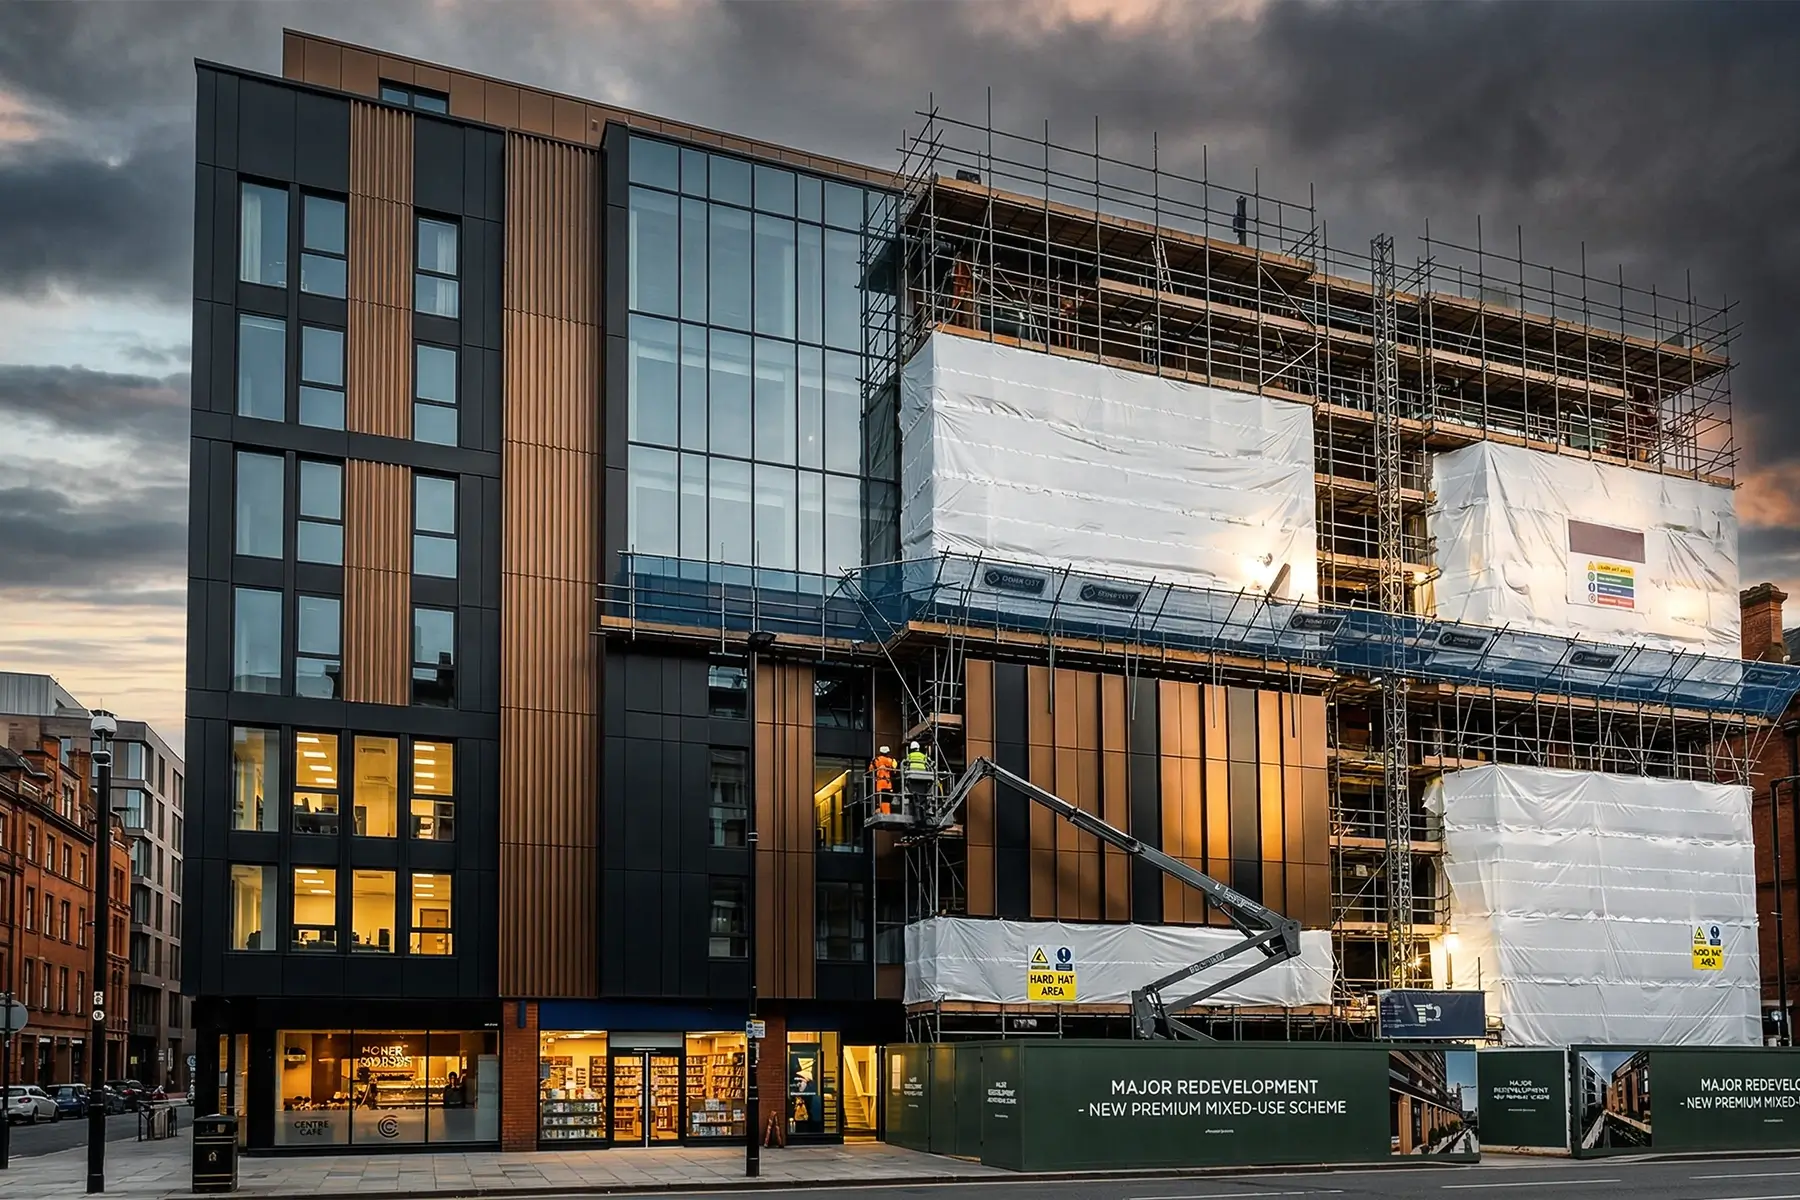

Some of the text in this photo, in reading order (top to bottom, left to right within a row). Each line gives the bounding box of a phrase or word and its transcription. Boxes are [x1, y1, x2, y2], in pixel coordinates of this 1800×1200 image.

[1030, 974, 1074, 984] HARD HAT
[1041, 986, 1064, 996] AREA
[1111, 1079, 1319, 1095] MAJOR REDEVELOPMENT
[1701, 1078, 1743, 1092] MAJOR
[1089, 1102, 1128, 1117] NEW
[1131, 1101, 1201, 1116] PREMIUM
[1205, 1100, 1286, 1115] MIXED-USE
[1289, 1100, 1347, 1115] SCHEME
[1687, 1096, 1713, 1109] NEW
[1715, 1096, 1762, 1109] PREMIUM
[1764, 1096, 1800, 1108] MIXED-
[294, 1120, 329, 1129] CENTRE
